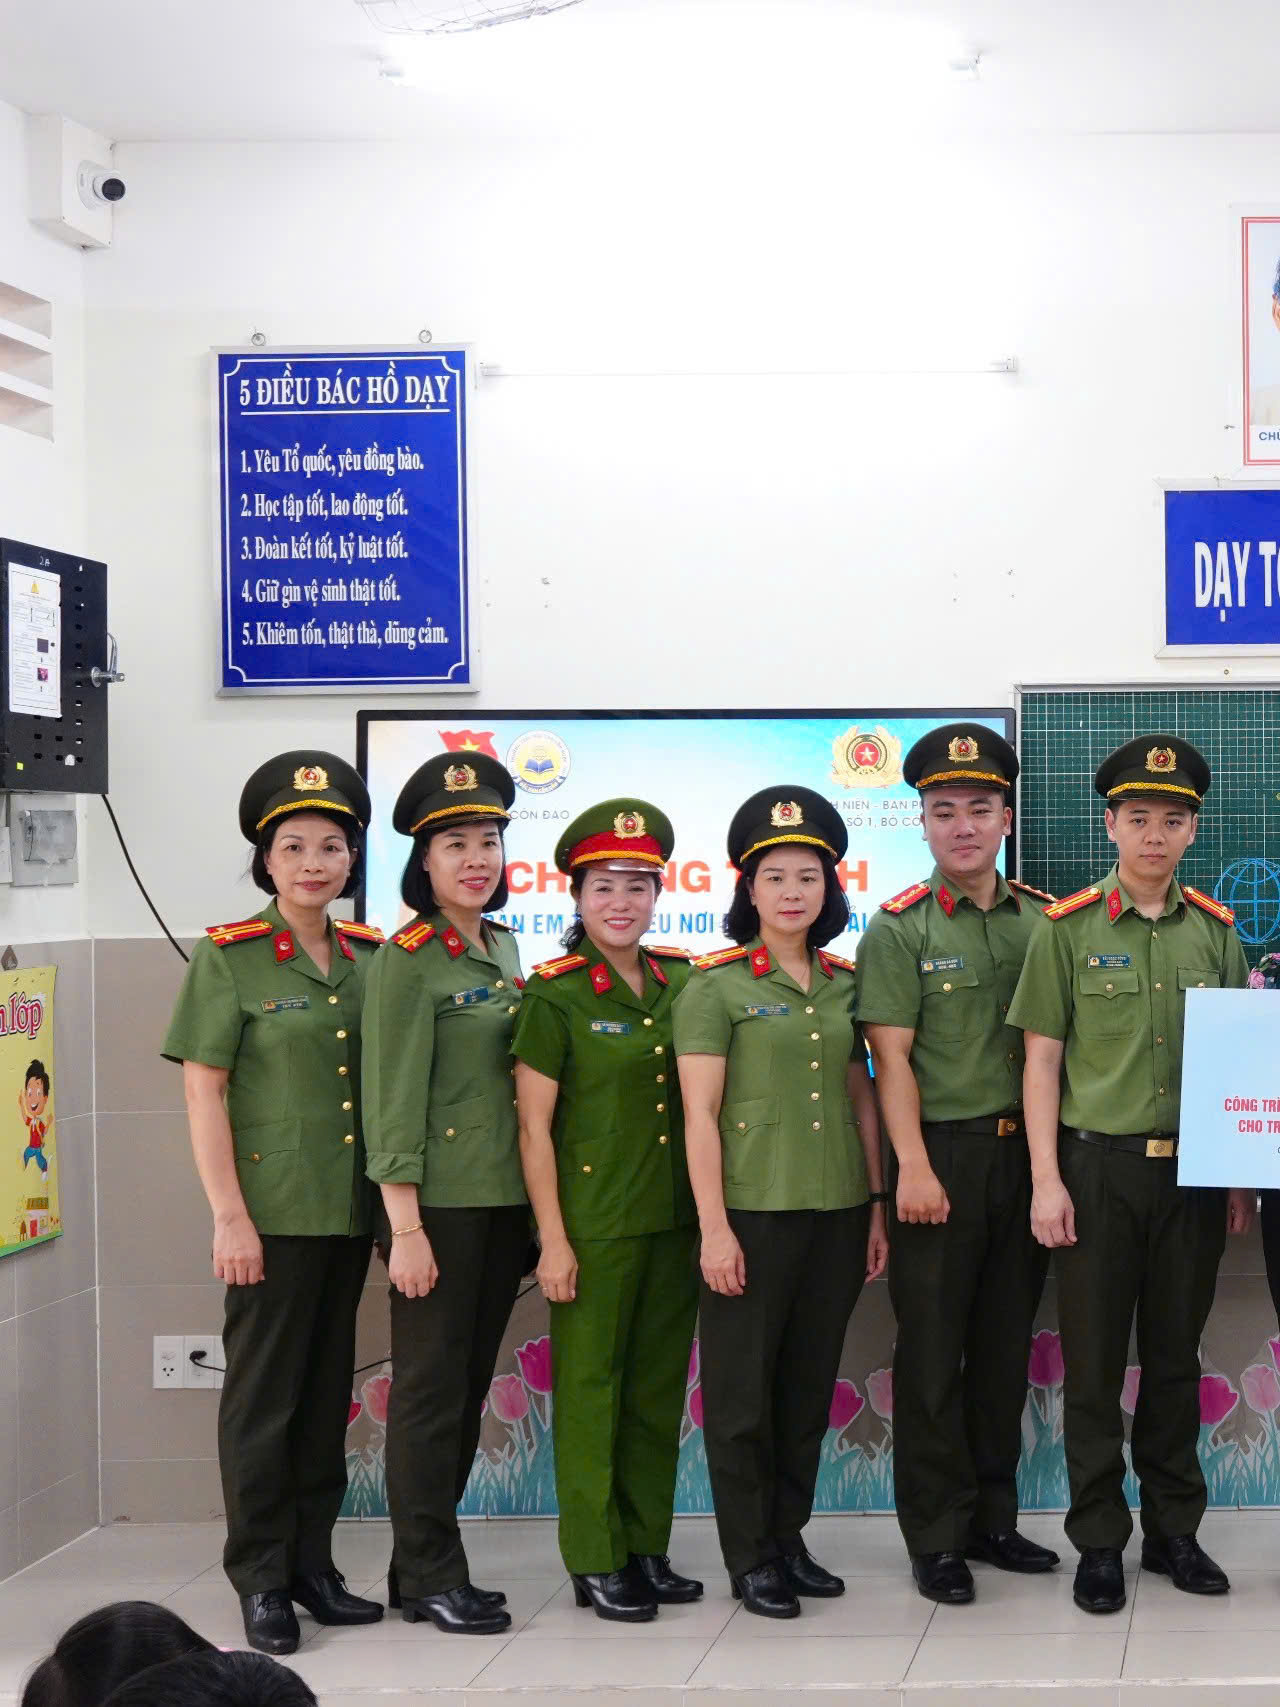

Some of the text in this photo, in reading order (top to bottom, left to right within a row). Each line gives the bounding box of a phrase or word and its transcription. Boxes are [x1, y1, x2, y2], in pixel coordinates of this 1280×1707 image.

[240, 361, 449, 410] 5 ĐIỀU BÁC HỒ DẠY
[241, 442, 424, 478] 1. Yêu Tổ quốc, yêu đồng bào.
[241, 488, 408, 522] 2. Học tập tốt, lao động tốt.
[241, 531, 408, 564] 3. Đoàn kết tốt, kỷ luật tốt.
[242, 574, 400, 608] 4. Giữ gìn vệ sinh thật tốt.
[1195, 542, 1250, 622] DẠY
[243, 617, 448, 650] 5. Khiêm tốn, thật thà, dũng cảm.
[534, 914, 563, 934] EM
[680, 912, 713, 933] NƠI
[9, 992, 42, 1040] lớp
[1224, 1096, 1258, 1112] CÔNG
[1239, 1120, 1262, 1133] CHO
